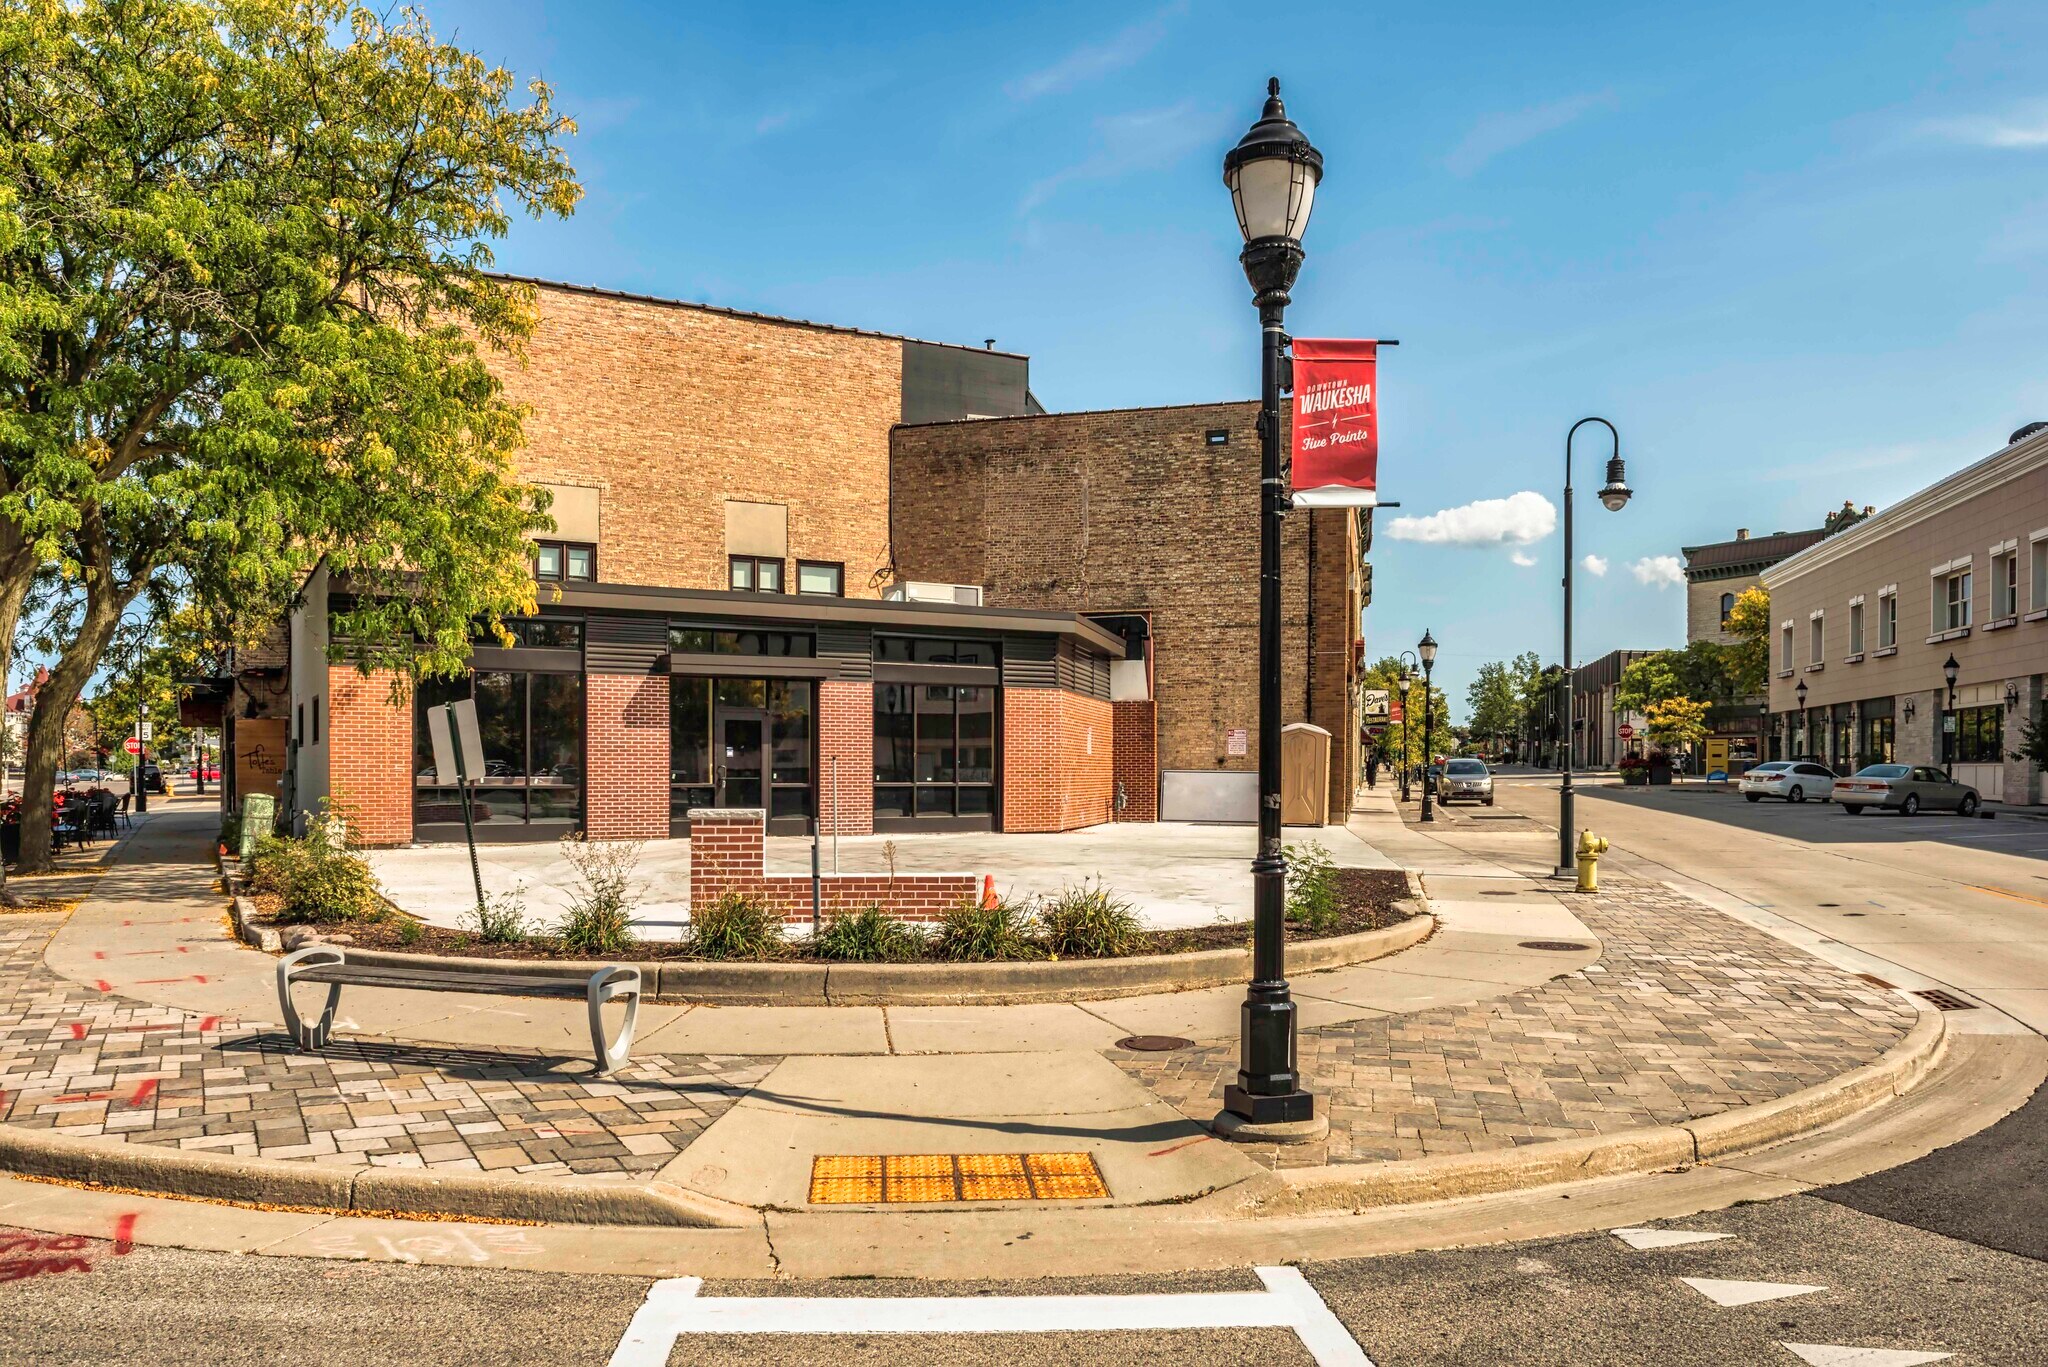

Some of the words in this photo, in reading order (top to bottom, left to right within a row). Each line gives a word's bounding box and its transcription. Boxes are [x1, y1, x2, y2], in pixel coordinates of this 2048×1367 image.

[1306, 379, 1348, 394] DOWNTOWN
[1299, 383, 1371, 415] WAUKESHA
[1301, 437, 1327, 451] Five
[1329, 429, 1368, 446] Points
[1366, 693, 1388, 707] Dave's
